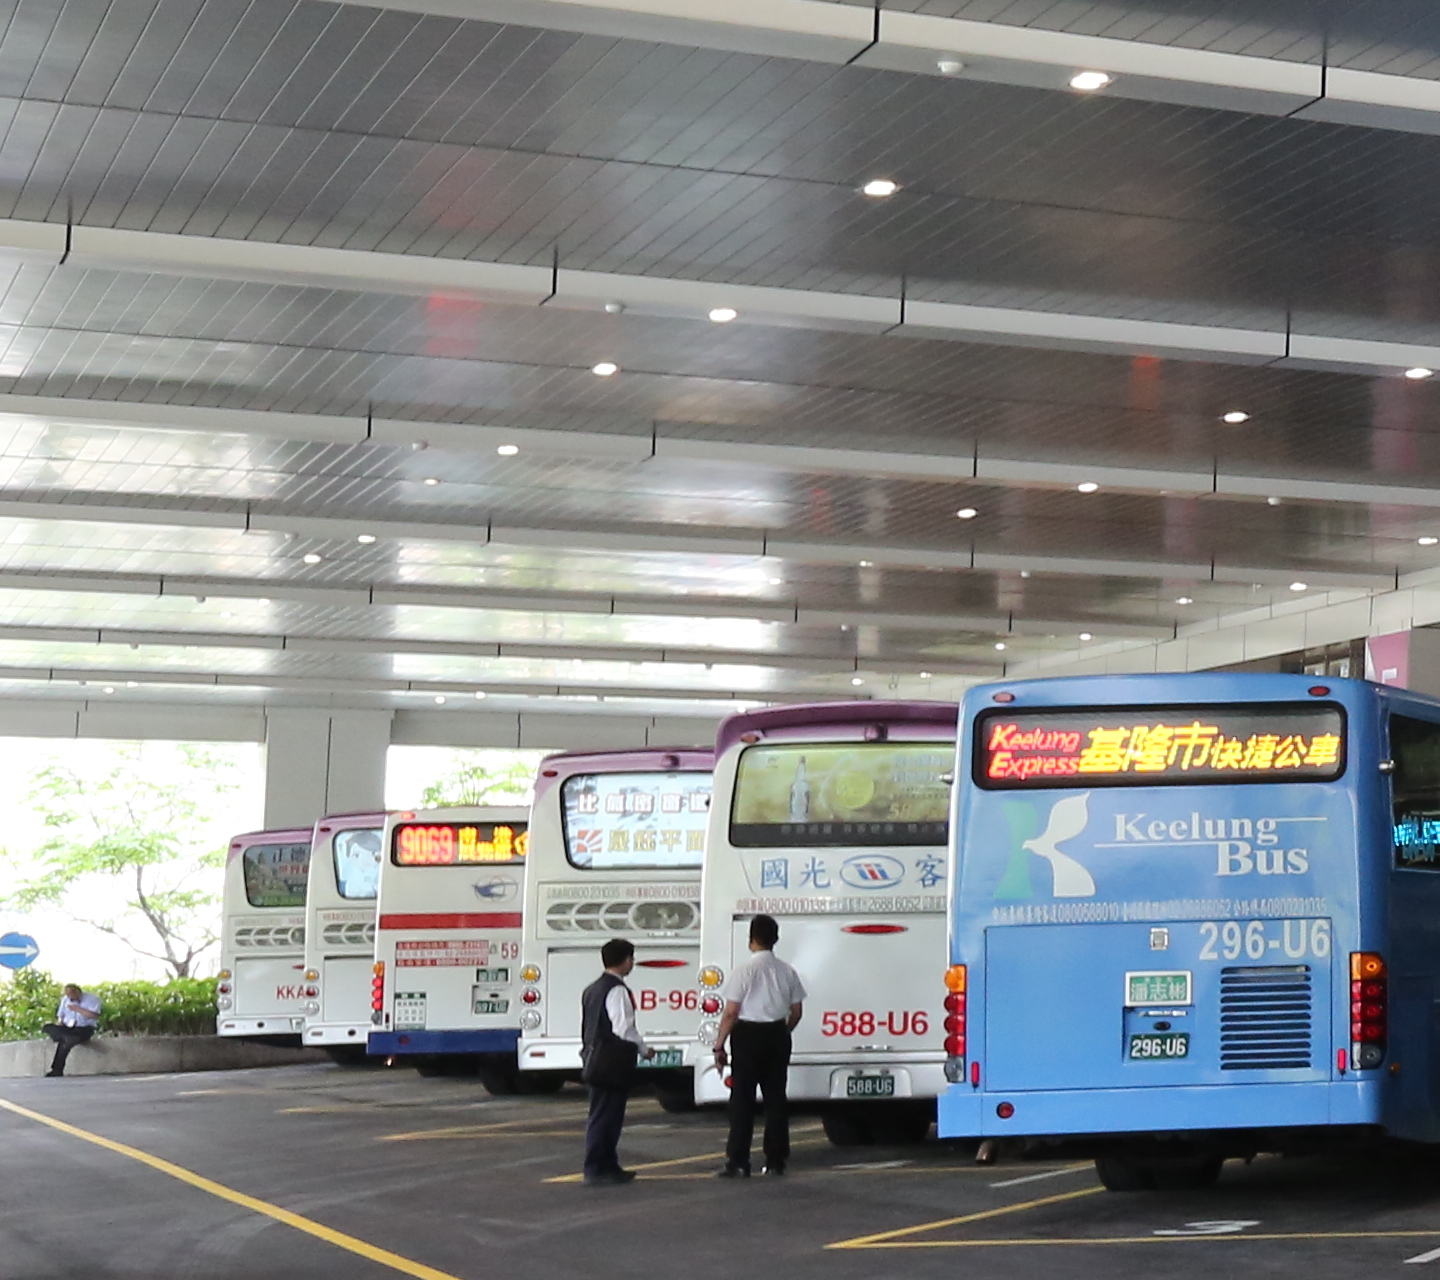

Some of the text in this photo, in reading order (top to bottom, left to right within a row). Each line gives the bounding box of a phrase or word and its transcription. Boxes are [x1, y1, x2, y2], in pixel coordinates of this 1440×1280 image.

[989, 724, 1081, 751] Keelung
[988, 752, 1080, 780] Express
[400, 826, 455, 863] 9069
[1113, 811, 1278, 846] Keelung
[761, 853, 946, 890] 國光 客
[1215, 841, 1309, 876] Bus
[1199, 920, 1330, 960] 296-U6
[821, 1011, 929, 1037] 588-U6
